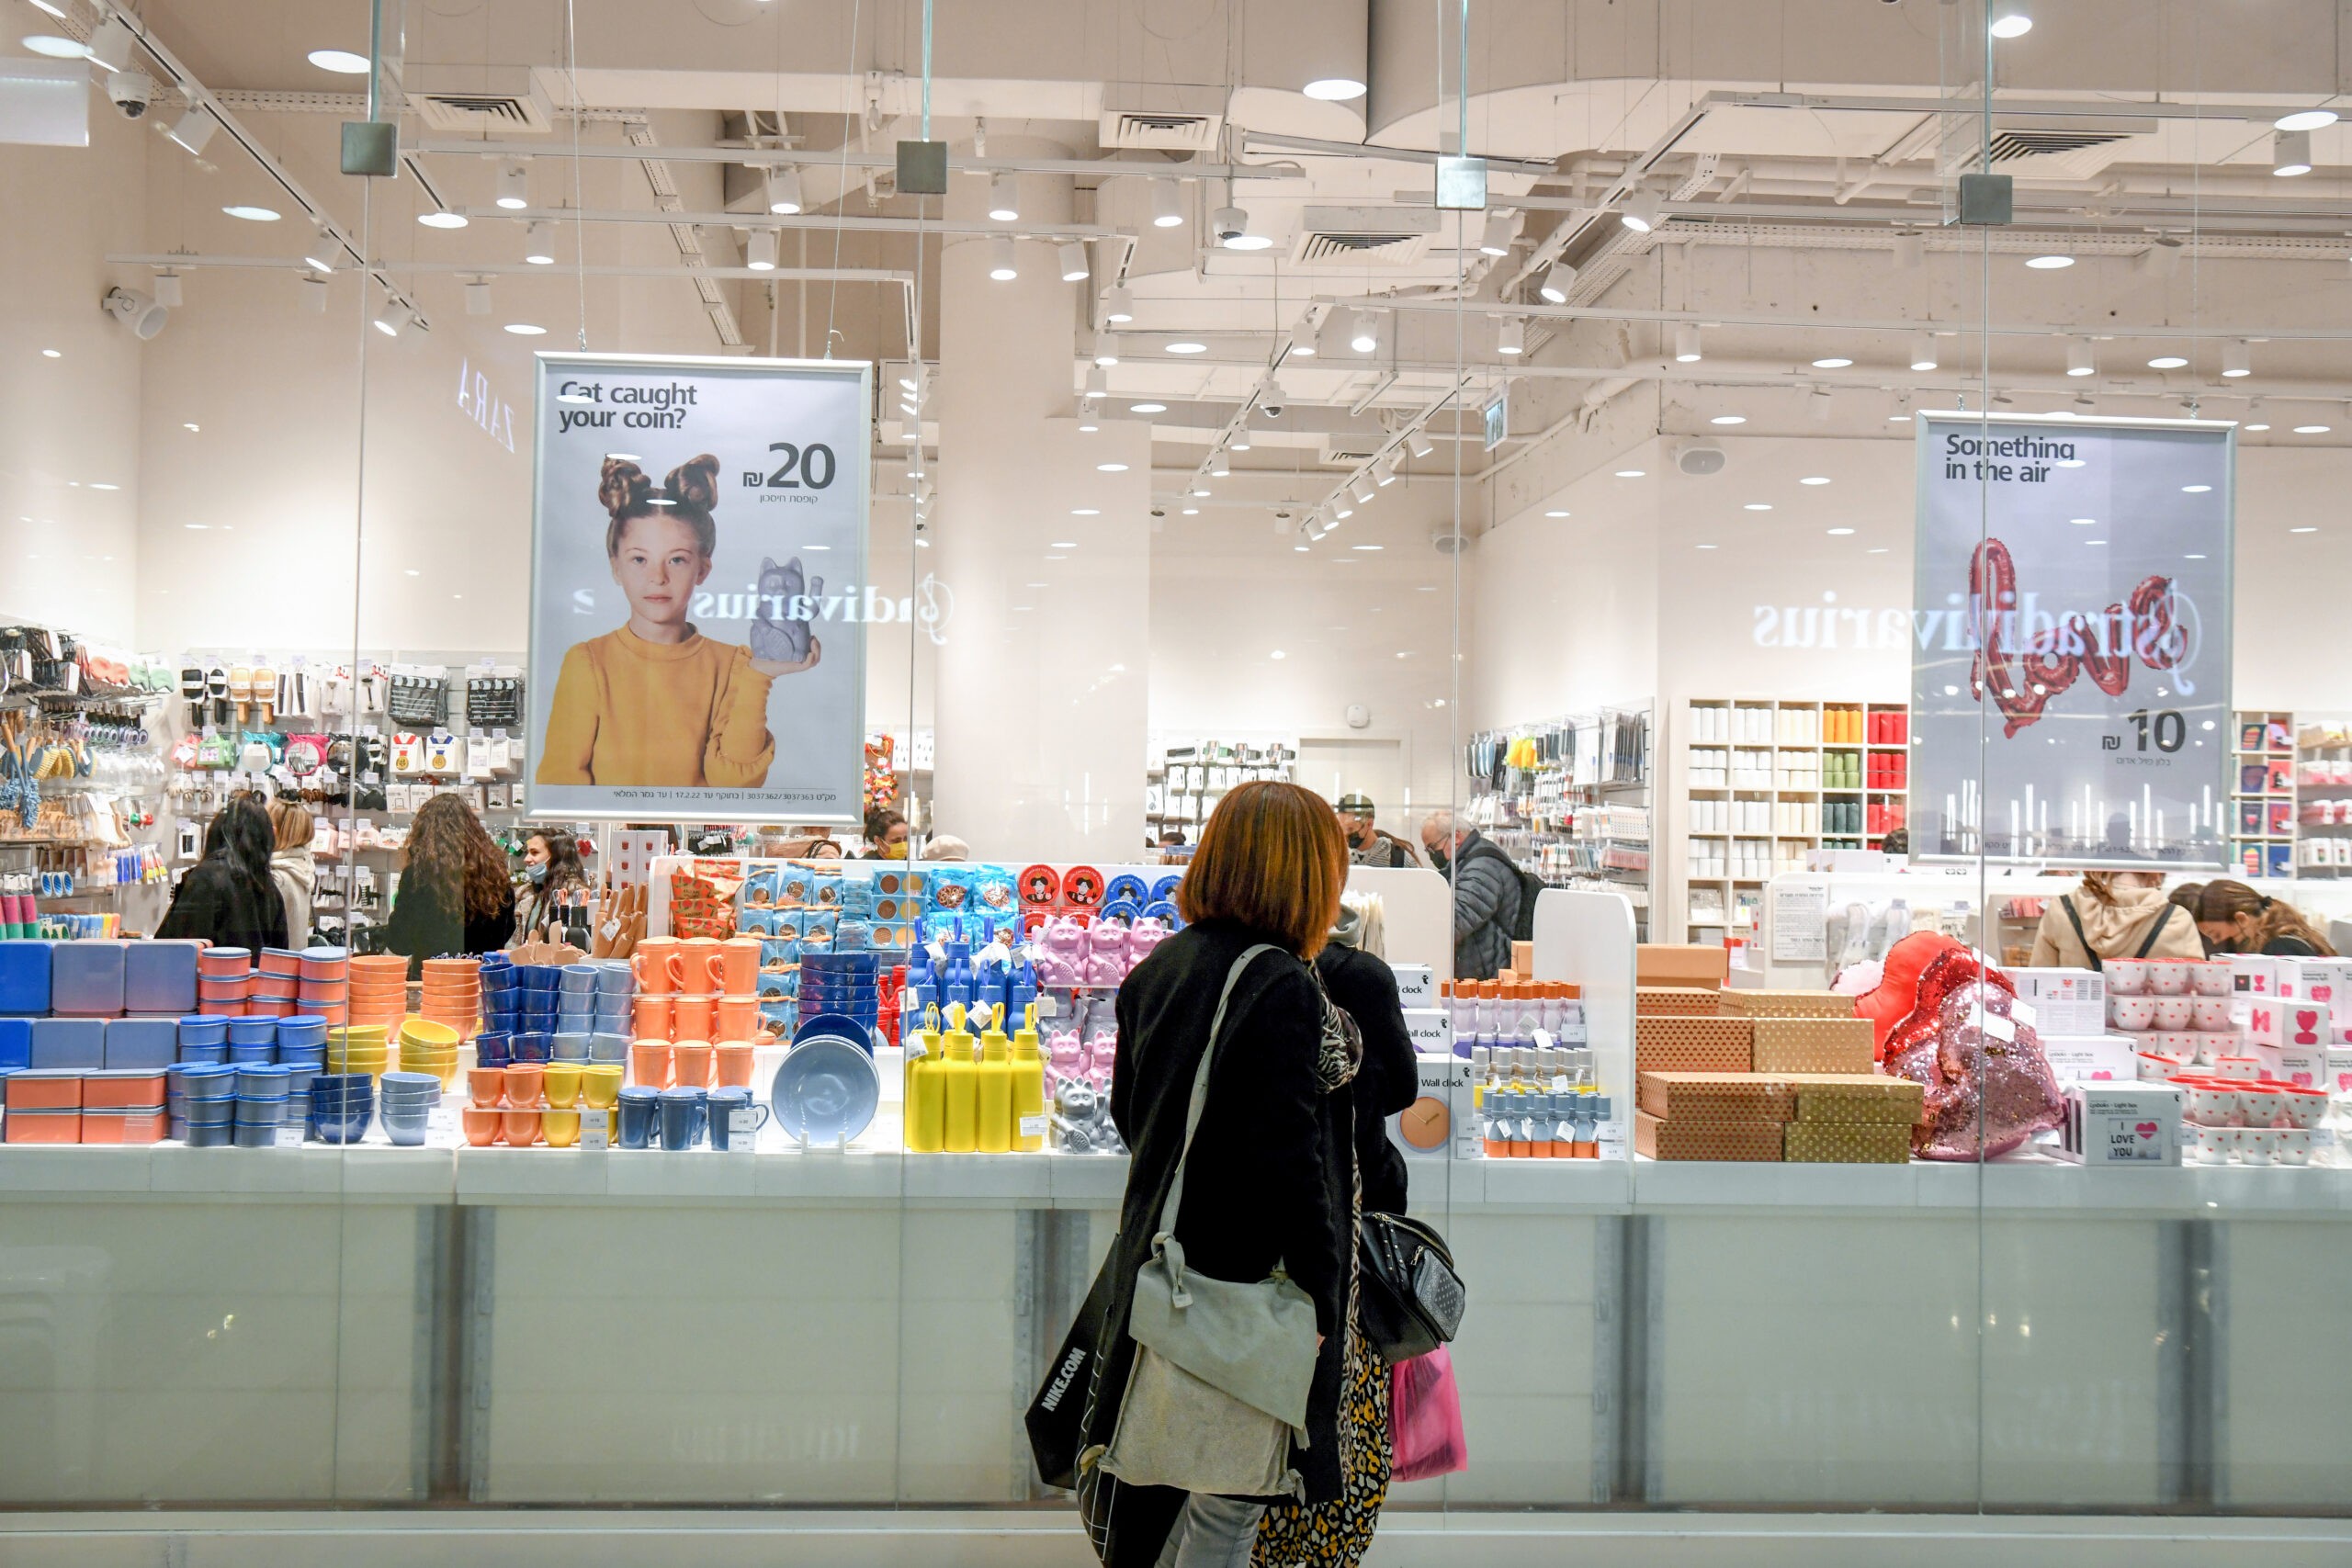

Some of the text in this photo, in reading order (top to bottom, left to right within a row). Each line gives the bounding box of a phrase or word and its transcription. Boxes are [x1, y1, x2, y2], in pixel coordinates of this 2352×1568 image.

[560, 381, 698, 411] Cat caught
[558, 408, 688, 434] your coin?
[1946, 434, 2076, 463] Something
[1946, 457, 2051, 483] in the air
[760, 493, 820, 505] קופסת חיסכון
[2127, 708, 2187, 753] 10
[1401, 986, 1422, 994] clock
[1419, 1029, 1442, 1038] clock
[1420, 1078, 1464, 1088] Wall clock
[2110, 1134, 2136, 1145] LOVE
[2113, 1147, 2133, 1156] YOU
[1041, 1347, 1087, 1412] NIKE.COM
